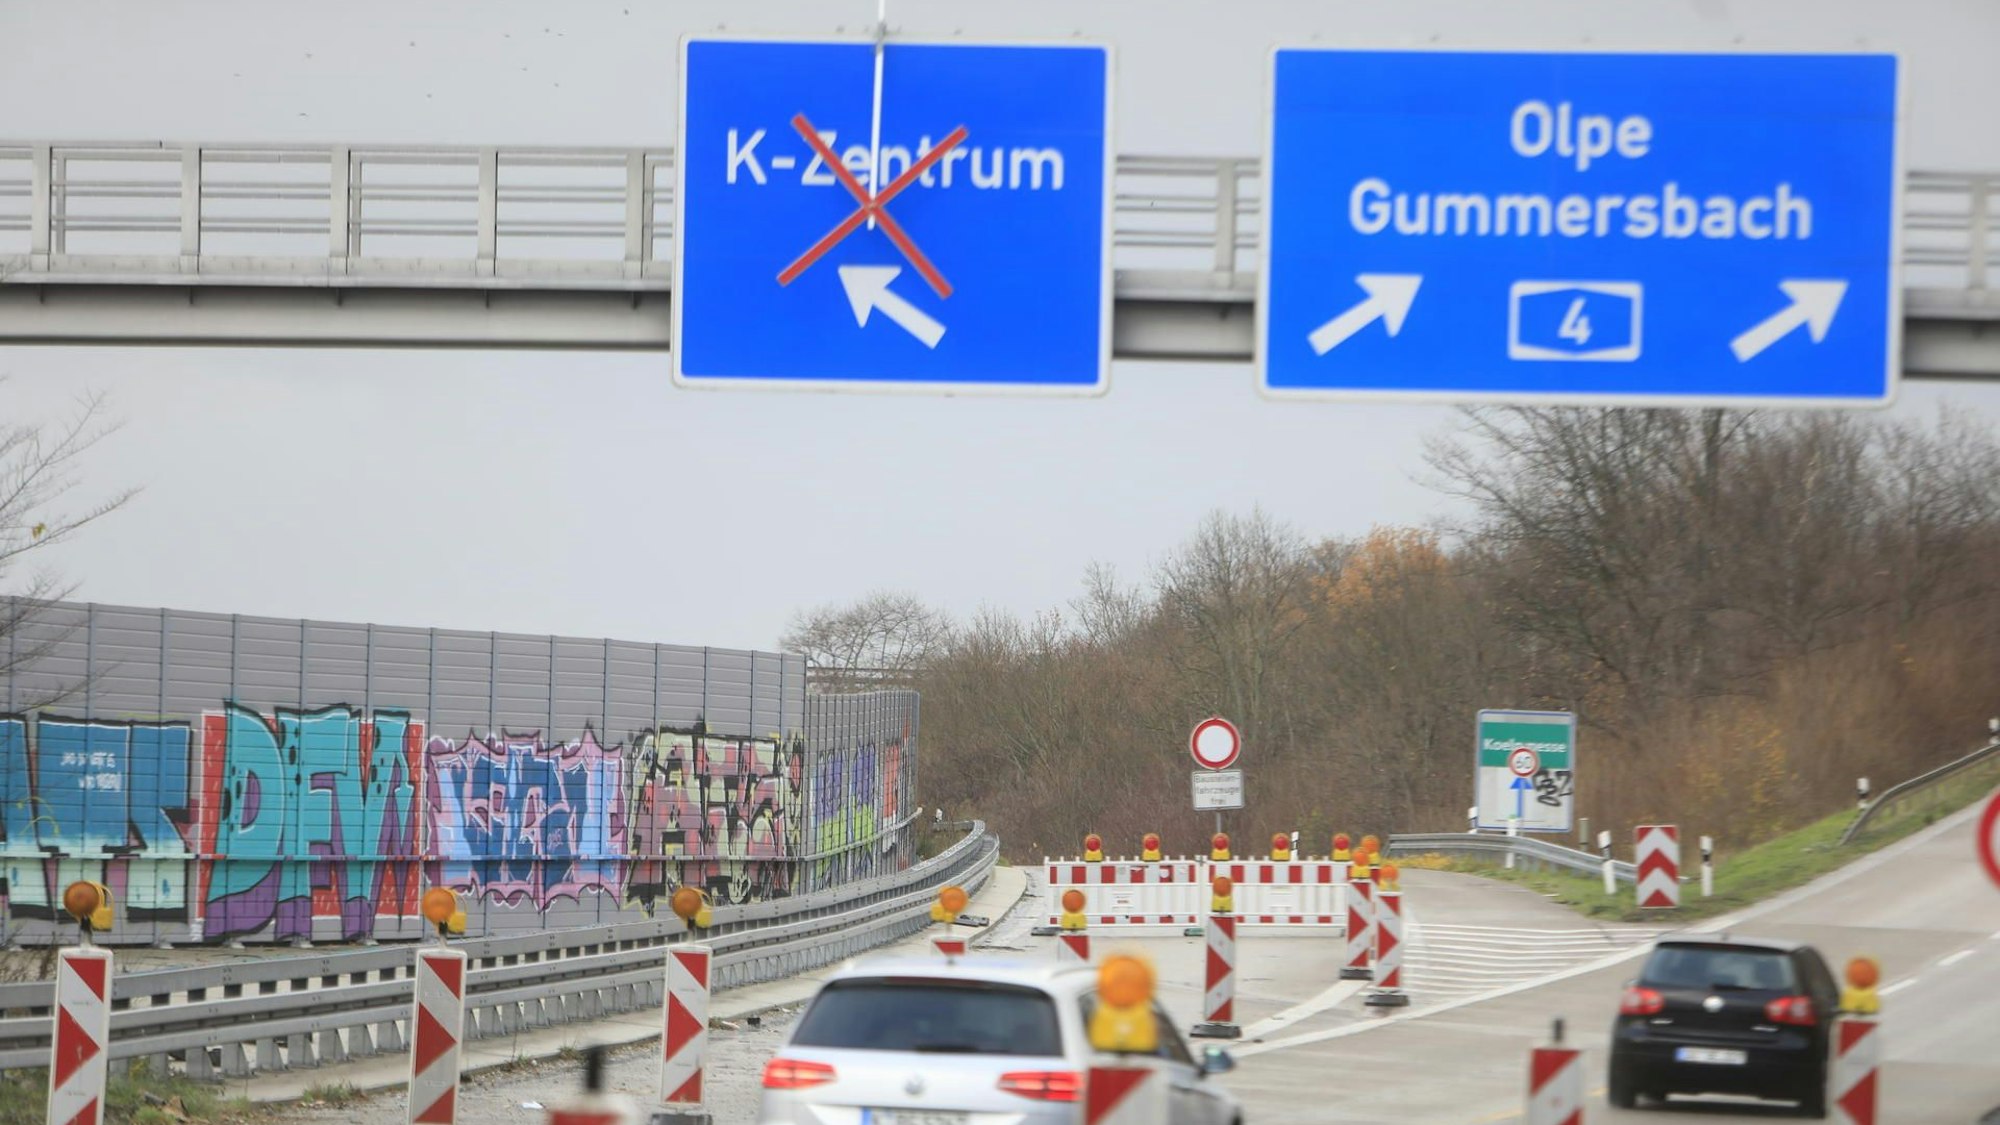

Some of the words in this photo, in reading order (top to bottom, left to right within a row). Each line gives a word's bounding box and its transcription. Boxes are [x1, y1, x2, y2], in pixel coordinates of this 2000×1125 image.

[726, 127, 1065, 190] K-Zentrum
[1509, 99, 1652, 172] Olpe
[1348, 177, 1813, 240] Gummersbach
[1557, 298, 1594, 346] 4
[1515, 754, 1533, 770] 60
